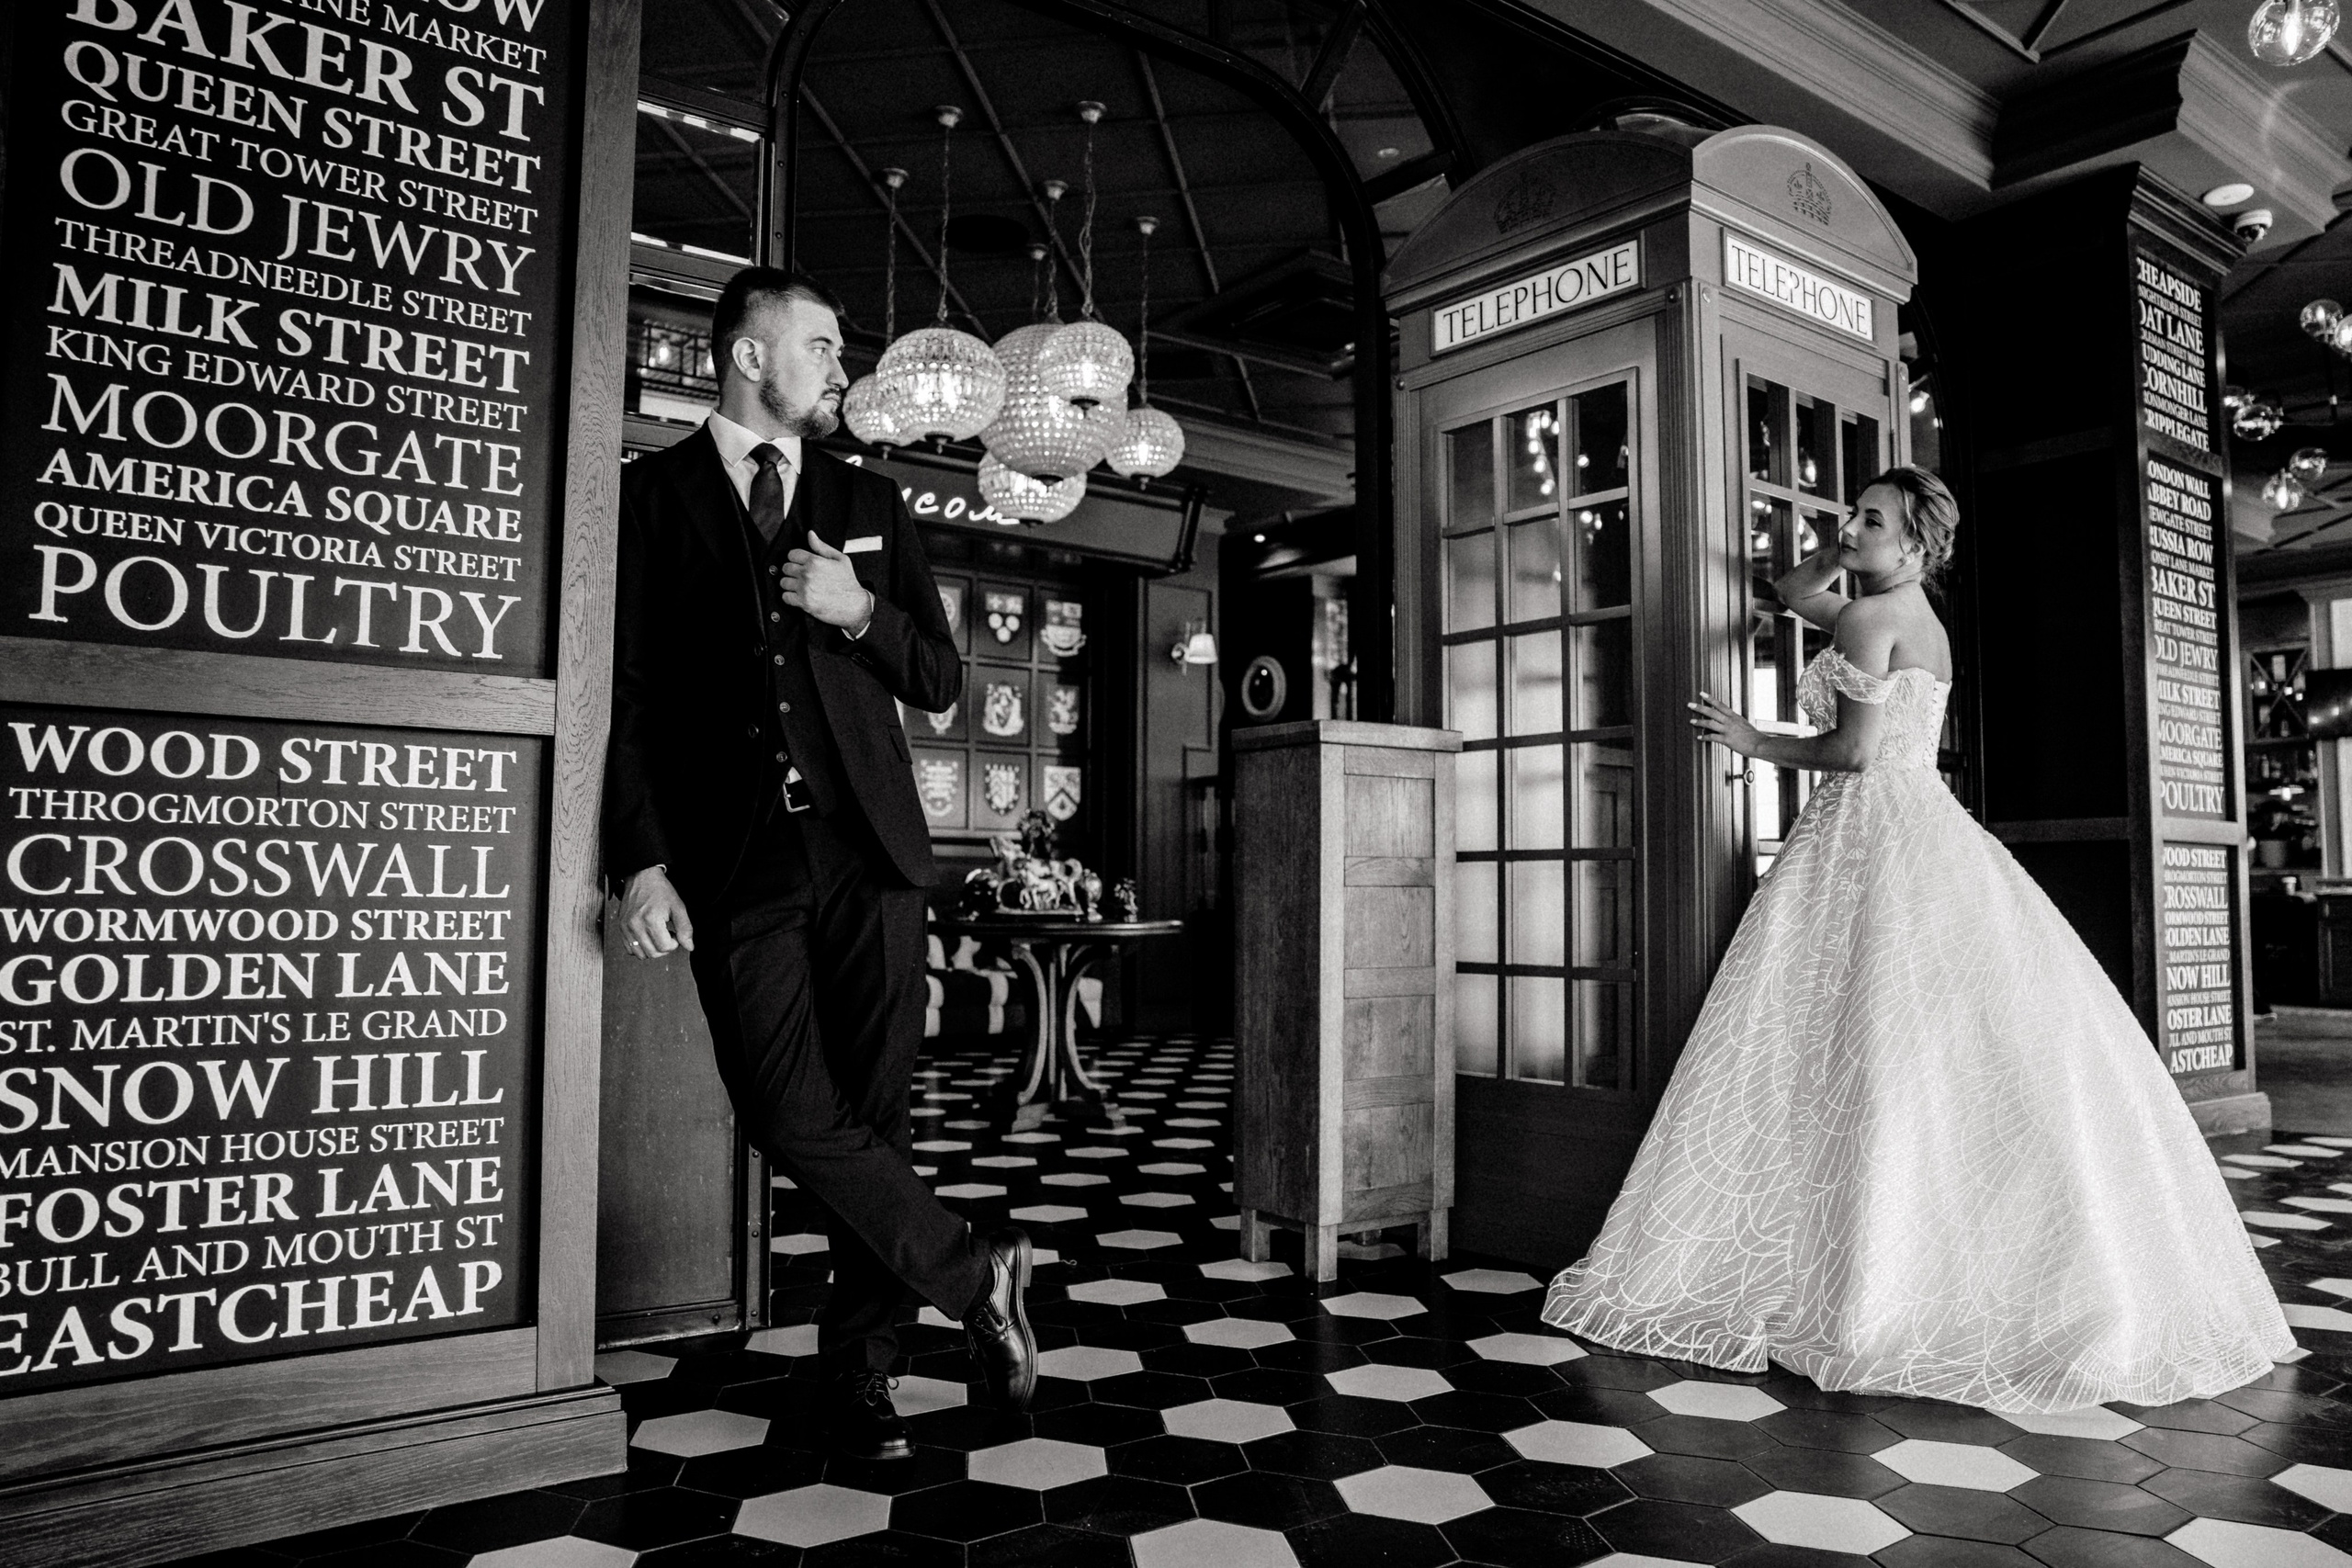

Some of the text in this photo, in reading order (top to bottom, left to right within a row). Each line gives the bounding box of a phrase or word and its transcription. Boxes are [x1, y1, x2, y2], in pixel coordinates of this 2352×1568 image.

[381, 5, 547, 74] MARKET
[64, 41, 540, 194] QUEEN STREET
[442, 66, 545, 141] ST
[62, 100, 537, 234] GREAT TOWER STREET
[61, 148, 536, 296] OLD JEWRY
[55, 218, 532, 336] THREADNEEDLE STREET
[1442, 247, 1632, 344] TELEPHONE
[1731, 243, 1869, 336] TELEPHONE
[2138, 284, 2179, 316] NIGHTRIDER
[47, 263, 529, 393] MILK STREET
[2166, 314, 2204, 355] LANE
[46, 326, 527, 432] KING EDWARD STREET
[2142, 342, 2206, 388] UDDING LANE
[41, 373, 524, 497] MOORGATE
[2144, 407, 2210, 452] RIPPLEGATE
[2188, 410, 2209, 431] LANE
[37, 448, 523, 543] AMERICA SQUARE
[2147, 459, 2211, 500] ONDON WALL
[2181, 492, 2211, 522] ROAD
[2185, 518, 2212, 541] STREET
[35, 502, 522, 582] QUEEN VICTORIA STREET
[2151, 549, 2170, 568] ONEY
[2186, 536, 2213, 565] ROW
[28, 545, 521, 659] POULTRY
[2198, 580, 2215, 608] ST
[2182, 604, 2217, 630] STREET
[2179, 641, 2218, 671] JEWRY
[2181, 684, 2220, 709] STREET
[8, 723, 517, 793] WOOD STREET
[2159, 745, 2223, 769] MERICA SQUARE
[9, 787, 516, 833] THROGMORTON STREET
[6, 833, 510, 898] CROSSWALL
[2190, 848, 2226, 869] STREET
[0, 908, 511, 942] WORMWOOD STREET
[2165, 910, 2204, 925] ORMWOOD
[2202, 926, 2230, 946] LANE
[0, 952, 509, 1006] GOLDEN LANE
[2166, 964, 2231, 991] NOW HILL
[0, 1009, 507, 1054] ST. MARTIN'S LE GRAND
[2167, 1004, 2232, 1031] OSTER LANE
[2181, 1031, 2197, 1045] AND
[2197, 1028, 2223, 1044] MOUTH
[2170, 1043, 2233, 1074] ASTCHEAP
[0, 1050, 503, 1134] SNOW HILL
[0, 1117, 504, 1179] MANSION HOUSE STREET
[0, 1156, 503, 1247] FOSTER LANE
[132, 1240, 249, 1282] AND
[262, 1220, 444, 1269] MOUTH
[456, 1213, 503, 1248] ST
